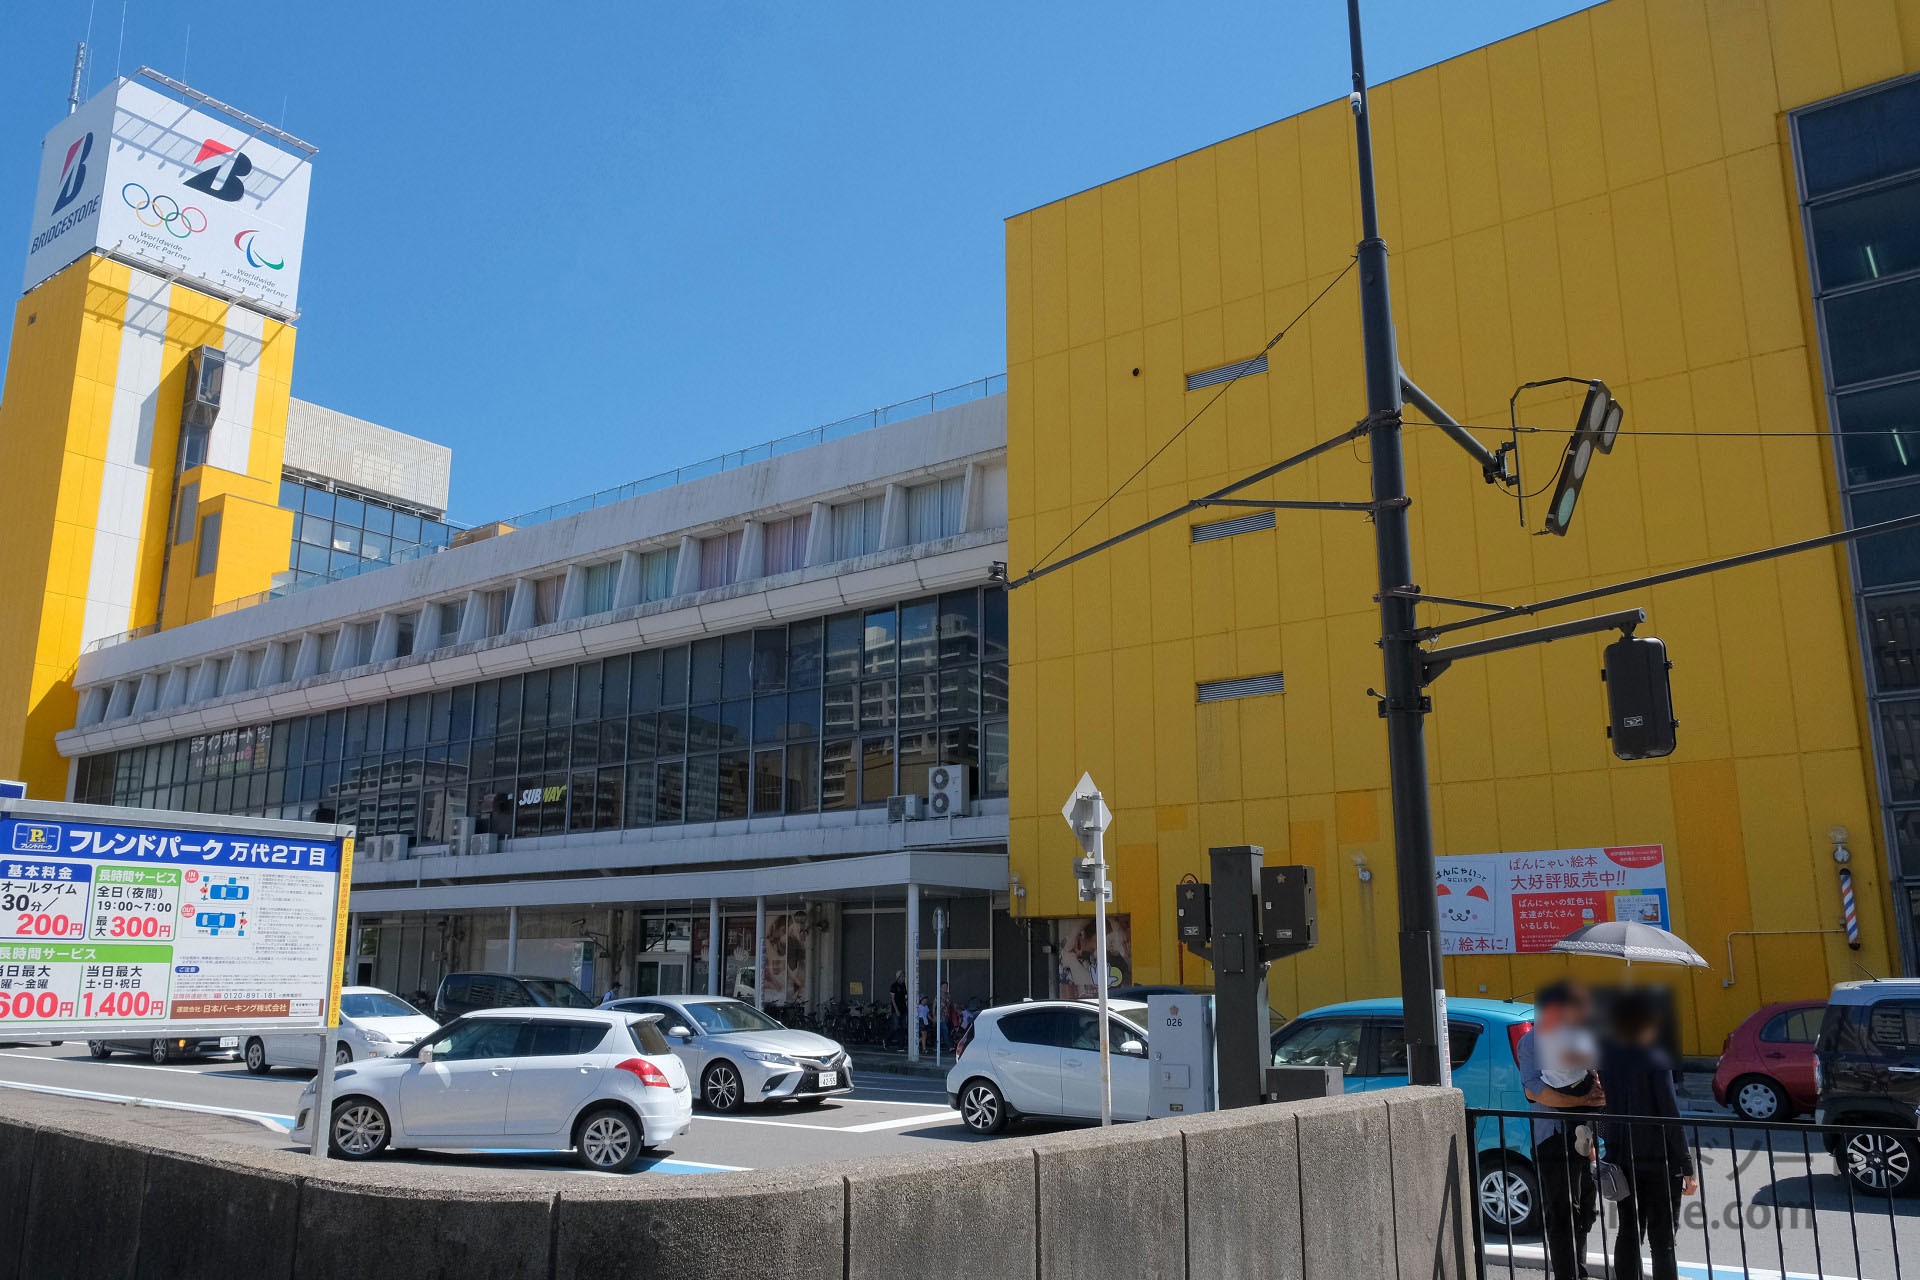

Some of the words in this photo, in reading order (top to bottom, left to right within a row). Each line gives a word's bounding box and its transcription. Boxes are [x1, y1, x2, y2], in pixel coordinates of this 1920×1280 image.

[31, 195, 100, 255] BRIDGESTONE
[128, 233, 160, 251] Olympic
[162, 246, 191, 262] Partner
[140, 231, 183, 251] Worldwide
[220, 269, 262, 289] Paralympic
[262, 285, 288, 300] Partner
[237, 268, 276, 287] Worldwide
[519, 784, 568, 806] SUBWAY
[69, 830, 223, 860] フレンドパーク
[229, 842, 326, 866] 万代2丁目
[1509, 854, 1598, 871] ばんにゃい絵本
[8, 864, 73, 880] 基本料金
[99, 868, 177, 884] 長時間サービス
[1511, 870, 1626, 890] 大好評販売中!!
[1, 881, 77, 895] オールタイム
[97, 886, 164, 900] 全日（夜間）
[1520, 910, 1575, 919] 友達がたくさん
[16, 913, 83, 936] 200円
[110, 916, 171, 937] 300円
[1520, 922, 1560, 930] いるしるし。
[1459, 936, 1508, 951] 絵本に!
[86, 965, 142, 977] 当日最大
[85, 979, 141, 989] 土・日・祝日
[83, 991, 164, 1017] 1,400円
[1166, 1018, 1183, 1027] 026
